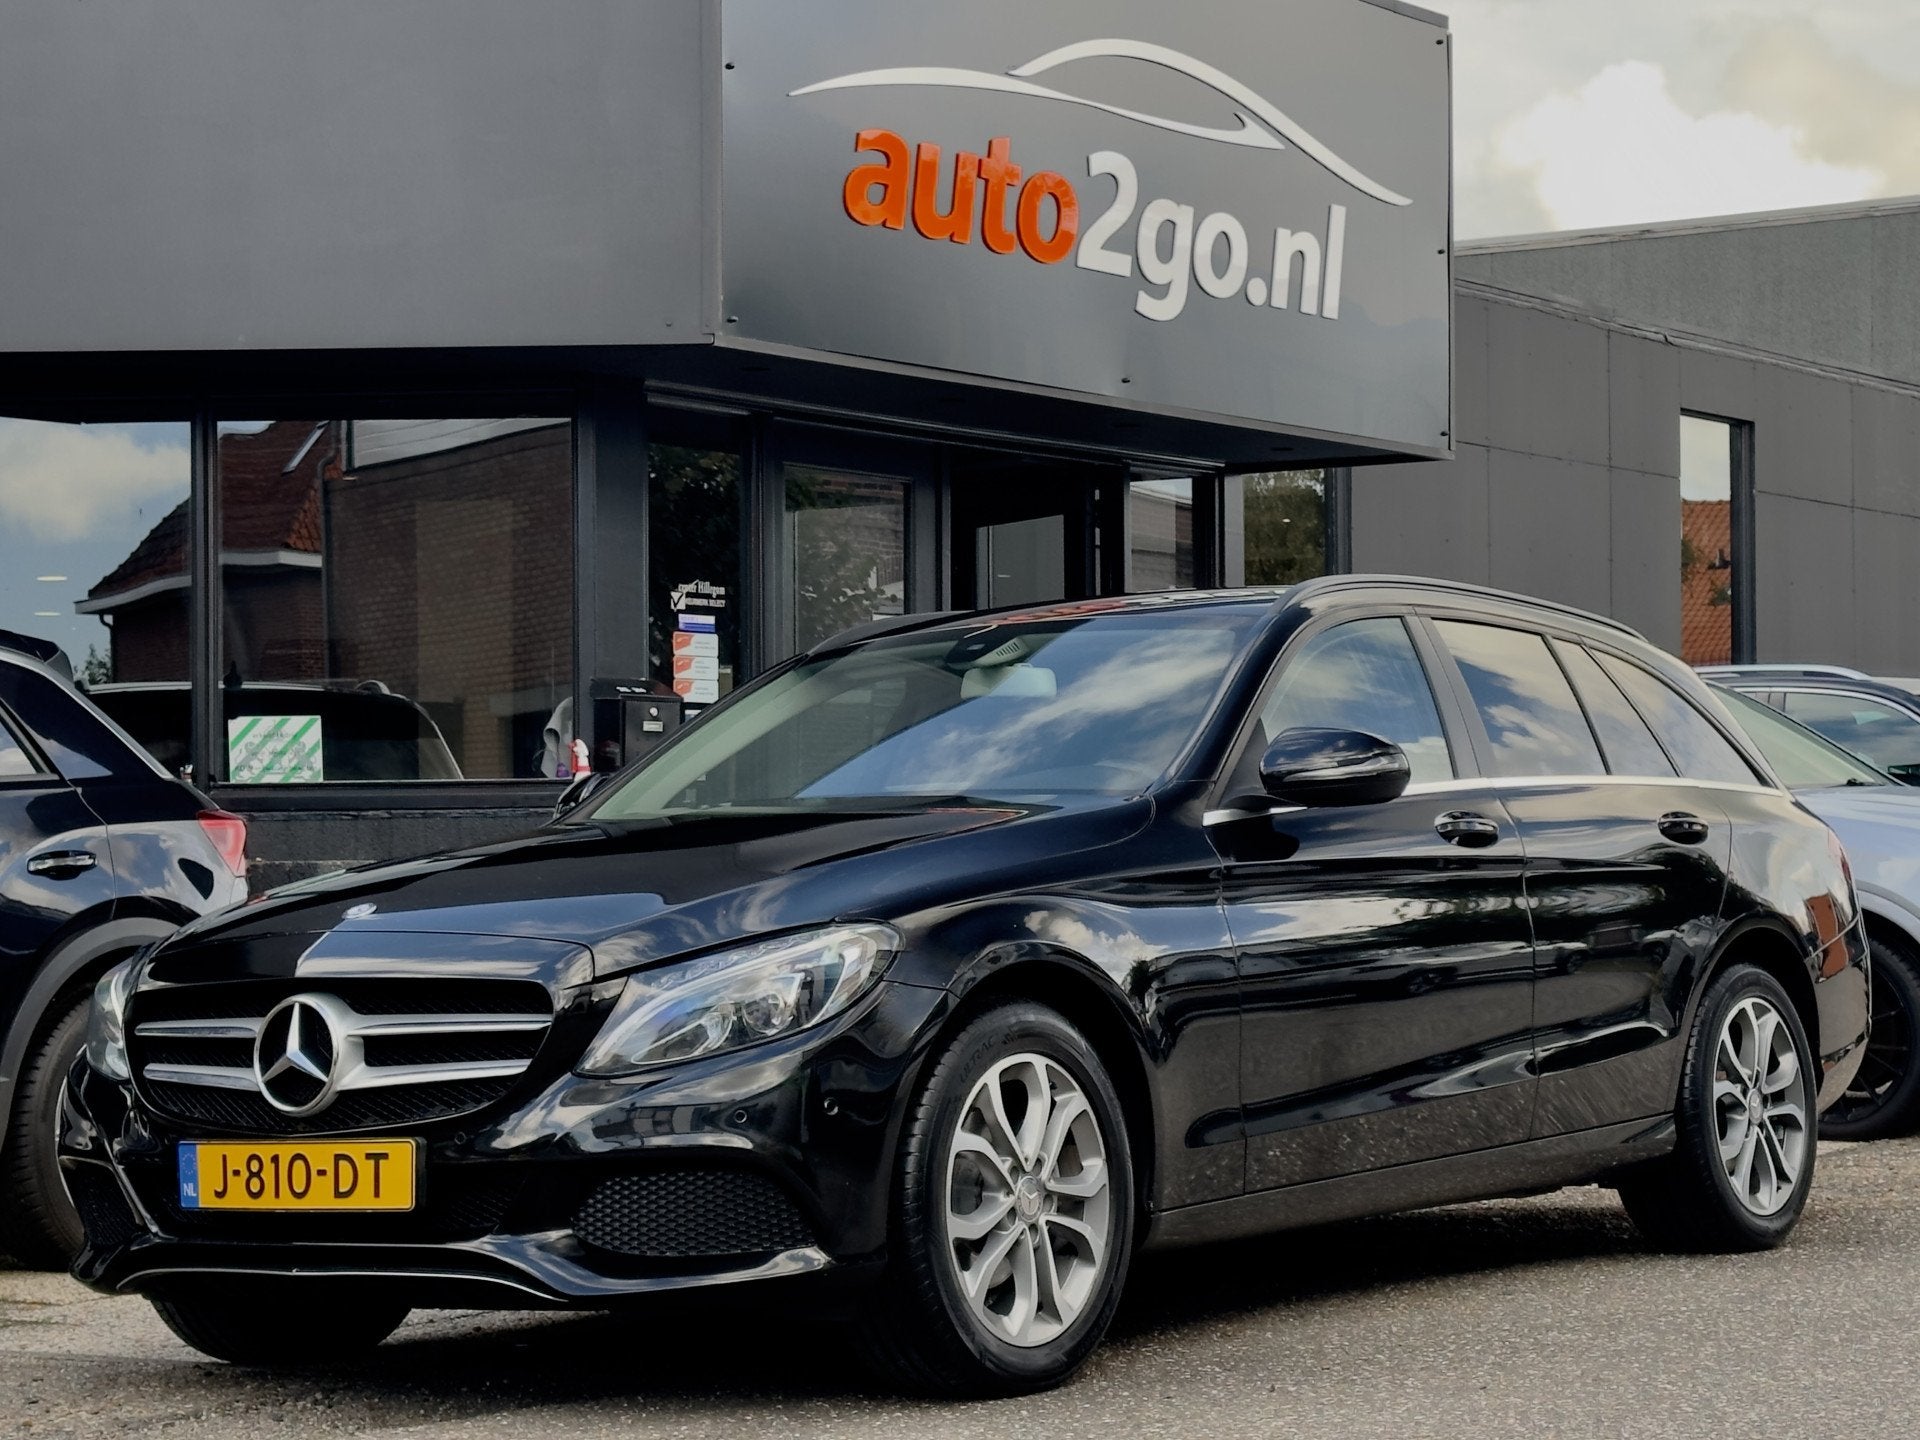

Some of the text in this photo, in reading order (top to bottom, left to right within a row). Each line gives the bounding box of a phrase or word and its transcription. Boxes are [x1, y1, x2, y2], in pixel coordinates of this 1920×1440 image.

[842, 129, 1347, 321] auto2go.nl
[183, 1182, 197, 1197] NL
[214, 1152, 389, 1199] J-810-DT
